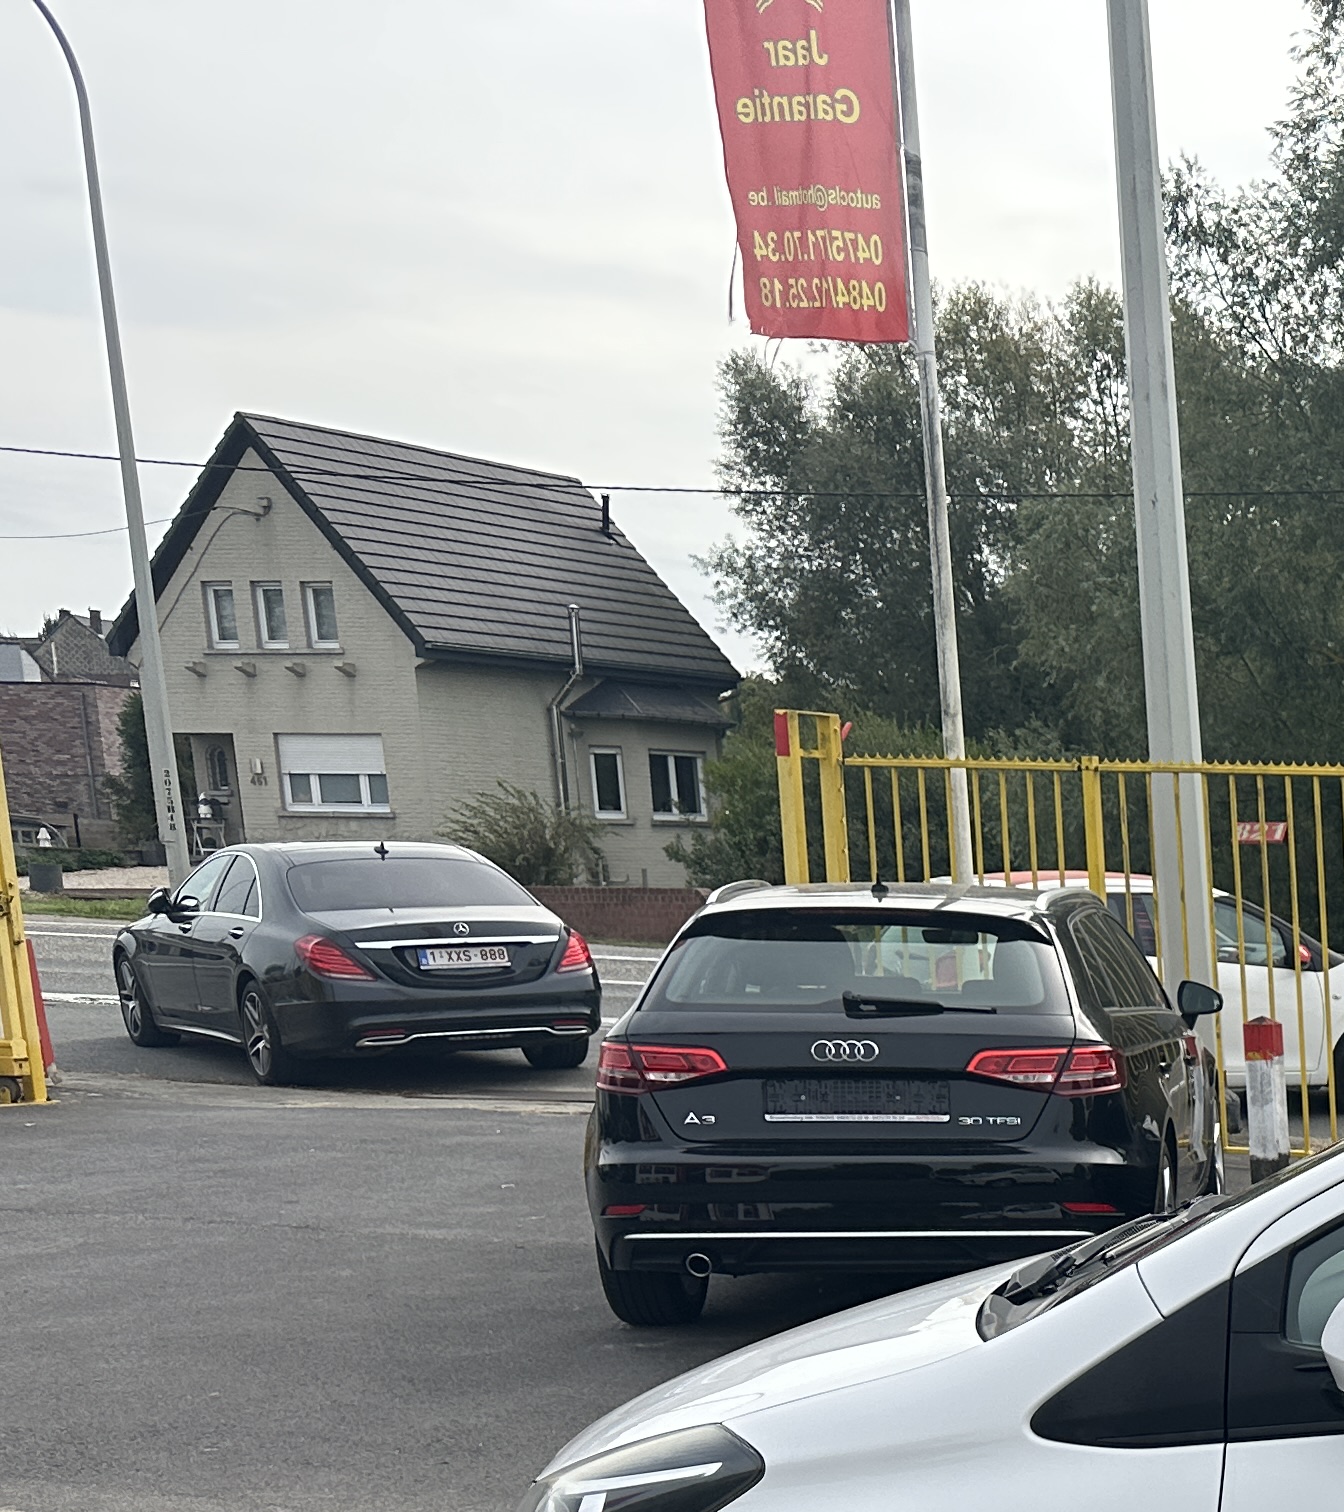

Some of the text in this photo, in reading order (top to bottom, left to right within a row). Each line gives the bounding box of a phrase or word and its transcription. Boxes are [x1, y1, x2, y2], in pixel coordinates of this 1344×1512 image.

[684, 1111, 716, 1125] A3
[958, 1116, 983, 1126] 30
[985, 1116, 1022, 1126] TFSI
